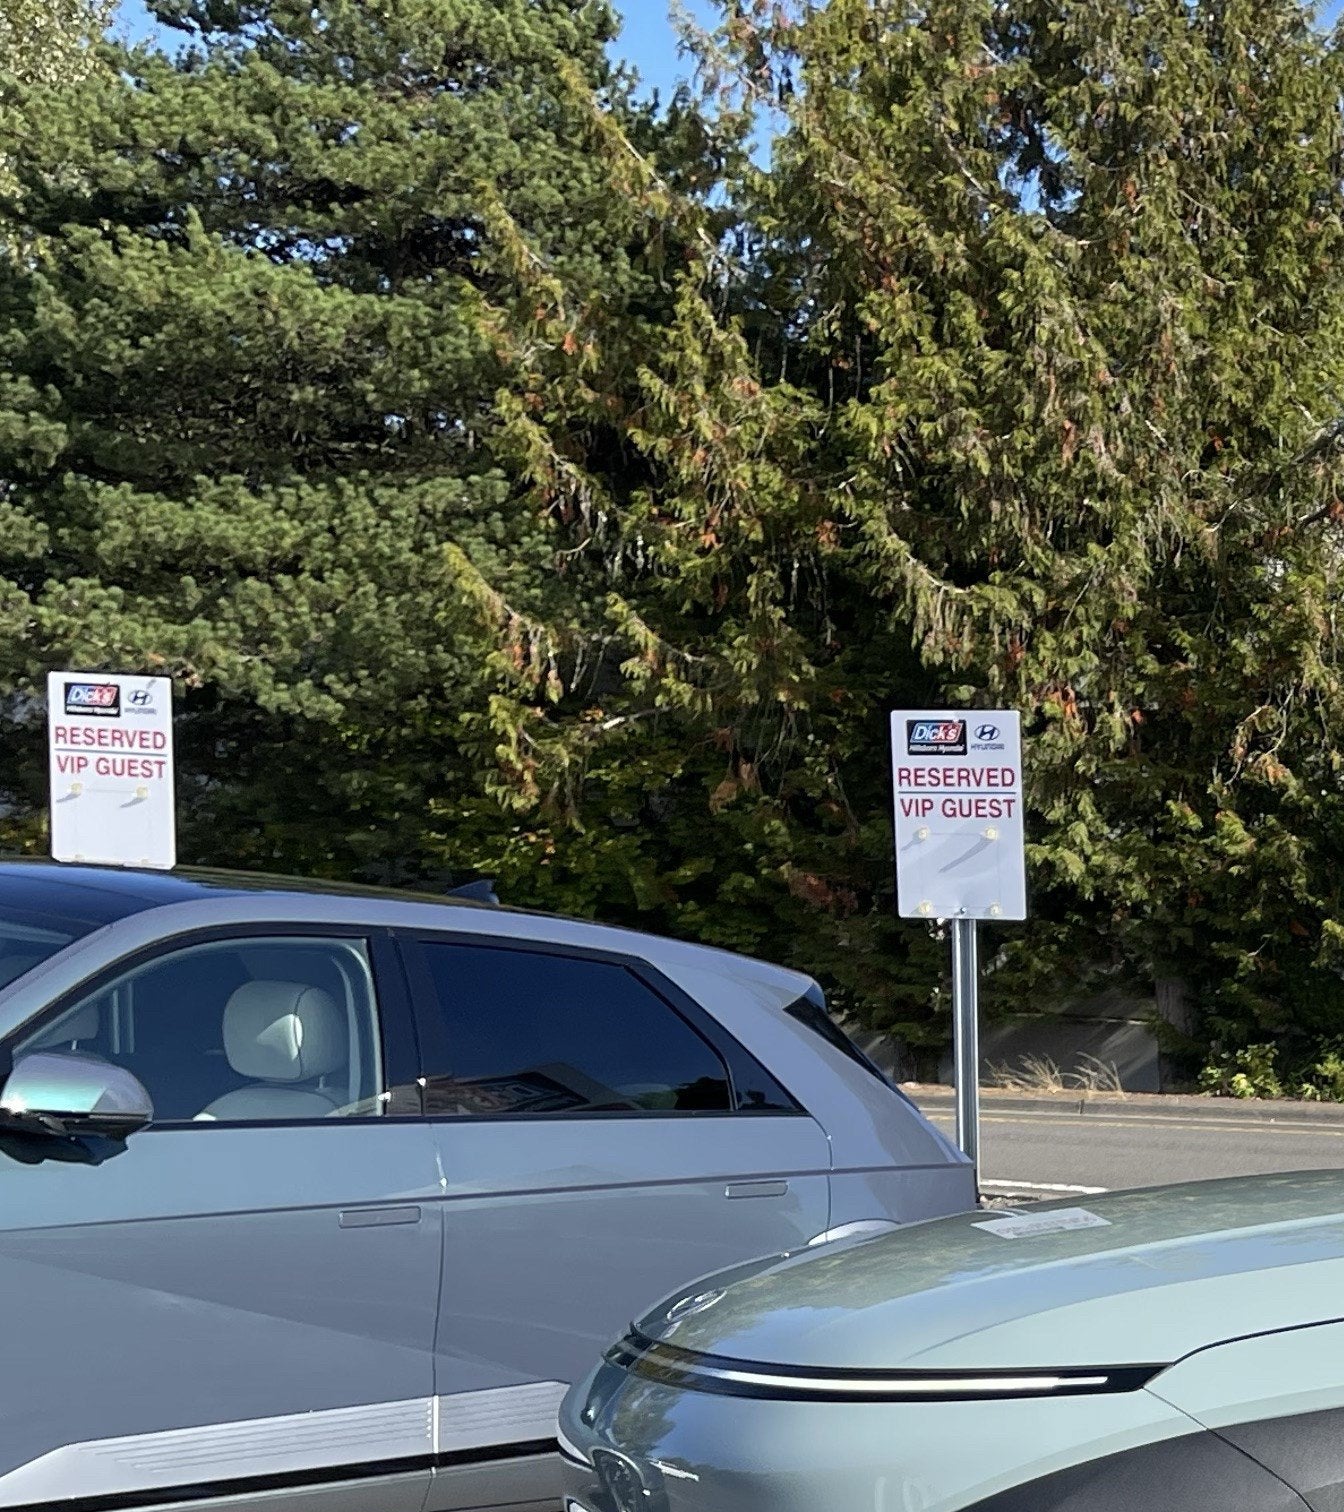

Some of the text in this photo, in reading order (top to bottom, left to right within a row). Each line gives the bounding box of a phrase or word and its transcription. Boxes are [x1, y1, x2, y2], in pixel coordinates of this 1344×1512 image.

[54, 726, 167, 749] RESERVED
[56, 755, 166, 779] VIP GUEST
[898, 767, 1015, 787] RESERVED
[900, 798, 1016, 818] VIP GUEST
